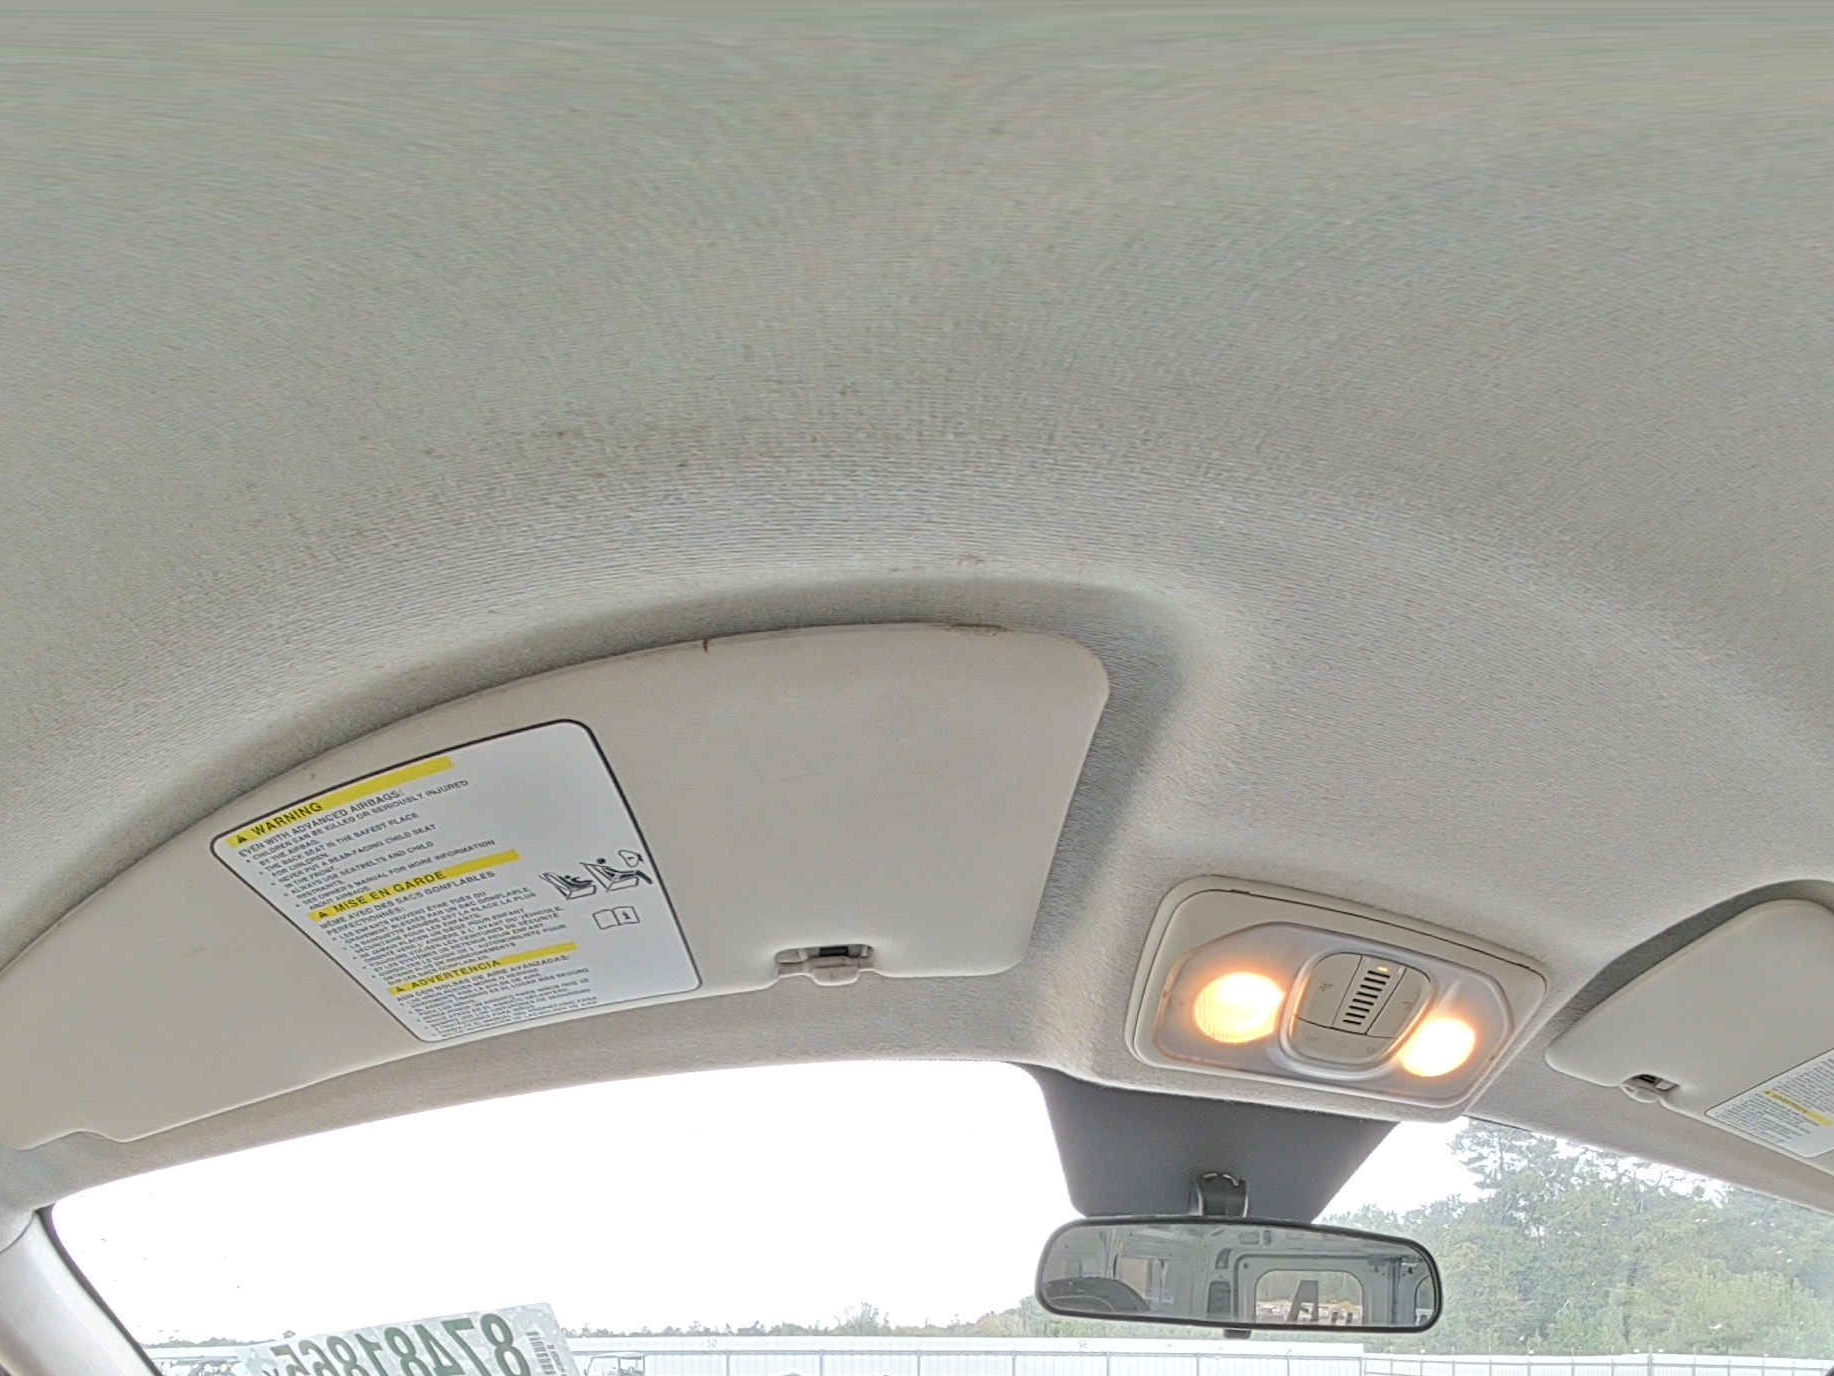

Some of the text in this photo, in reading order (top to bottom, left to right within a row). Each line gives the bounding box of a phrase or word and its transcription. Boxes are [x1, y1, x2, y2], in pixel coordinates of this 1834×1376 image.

[237, 789, 405, 857] EVEN WITH ADVANCED AIRBAGS:
[250, 801, 324, 836] WARNING
[251, 840, 293, 860] CHILDREN
[290, 832, 312, 843] CAN
[309, 827, 326, 836] BE
[370, 792, 424, 814] SERIOUSLY
[423, 779, 469, 796] INJURED
[383, 831, 412, 844] CHILD
[411, 823, 437, 835] SEAT
[258, 858, 272, 866] BY
[270, 851, 288, 861] THE
[264, 862, 282, 872] THE
[302, 844, 326, 856] SEAT
[335, 834, 354, 844] THE
[387, 812, 419, 826] PLACE
[406, 856, 433, 868] MORE
[432, 839, 496, 860] INFORMATION
[290, 879, 323, 894] ALWAYS
[386, 849, 407, 859] AND
[405, 840, 434, 853] CHILD
[331, 870, 446, 912] MISE EN GARDE
[346, 907, 374, 919] AVEC
[372, 900, 394, 910] DES
[393, 890, 424, 903] SACS
[422, 870, 495, 894] GONFLABLES
[409, 959, 501, 988] ADVERTENCIA
